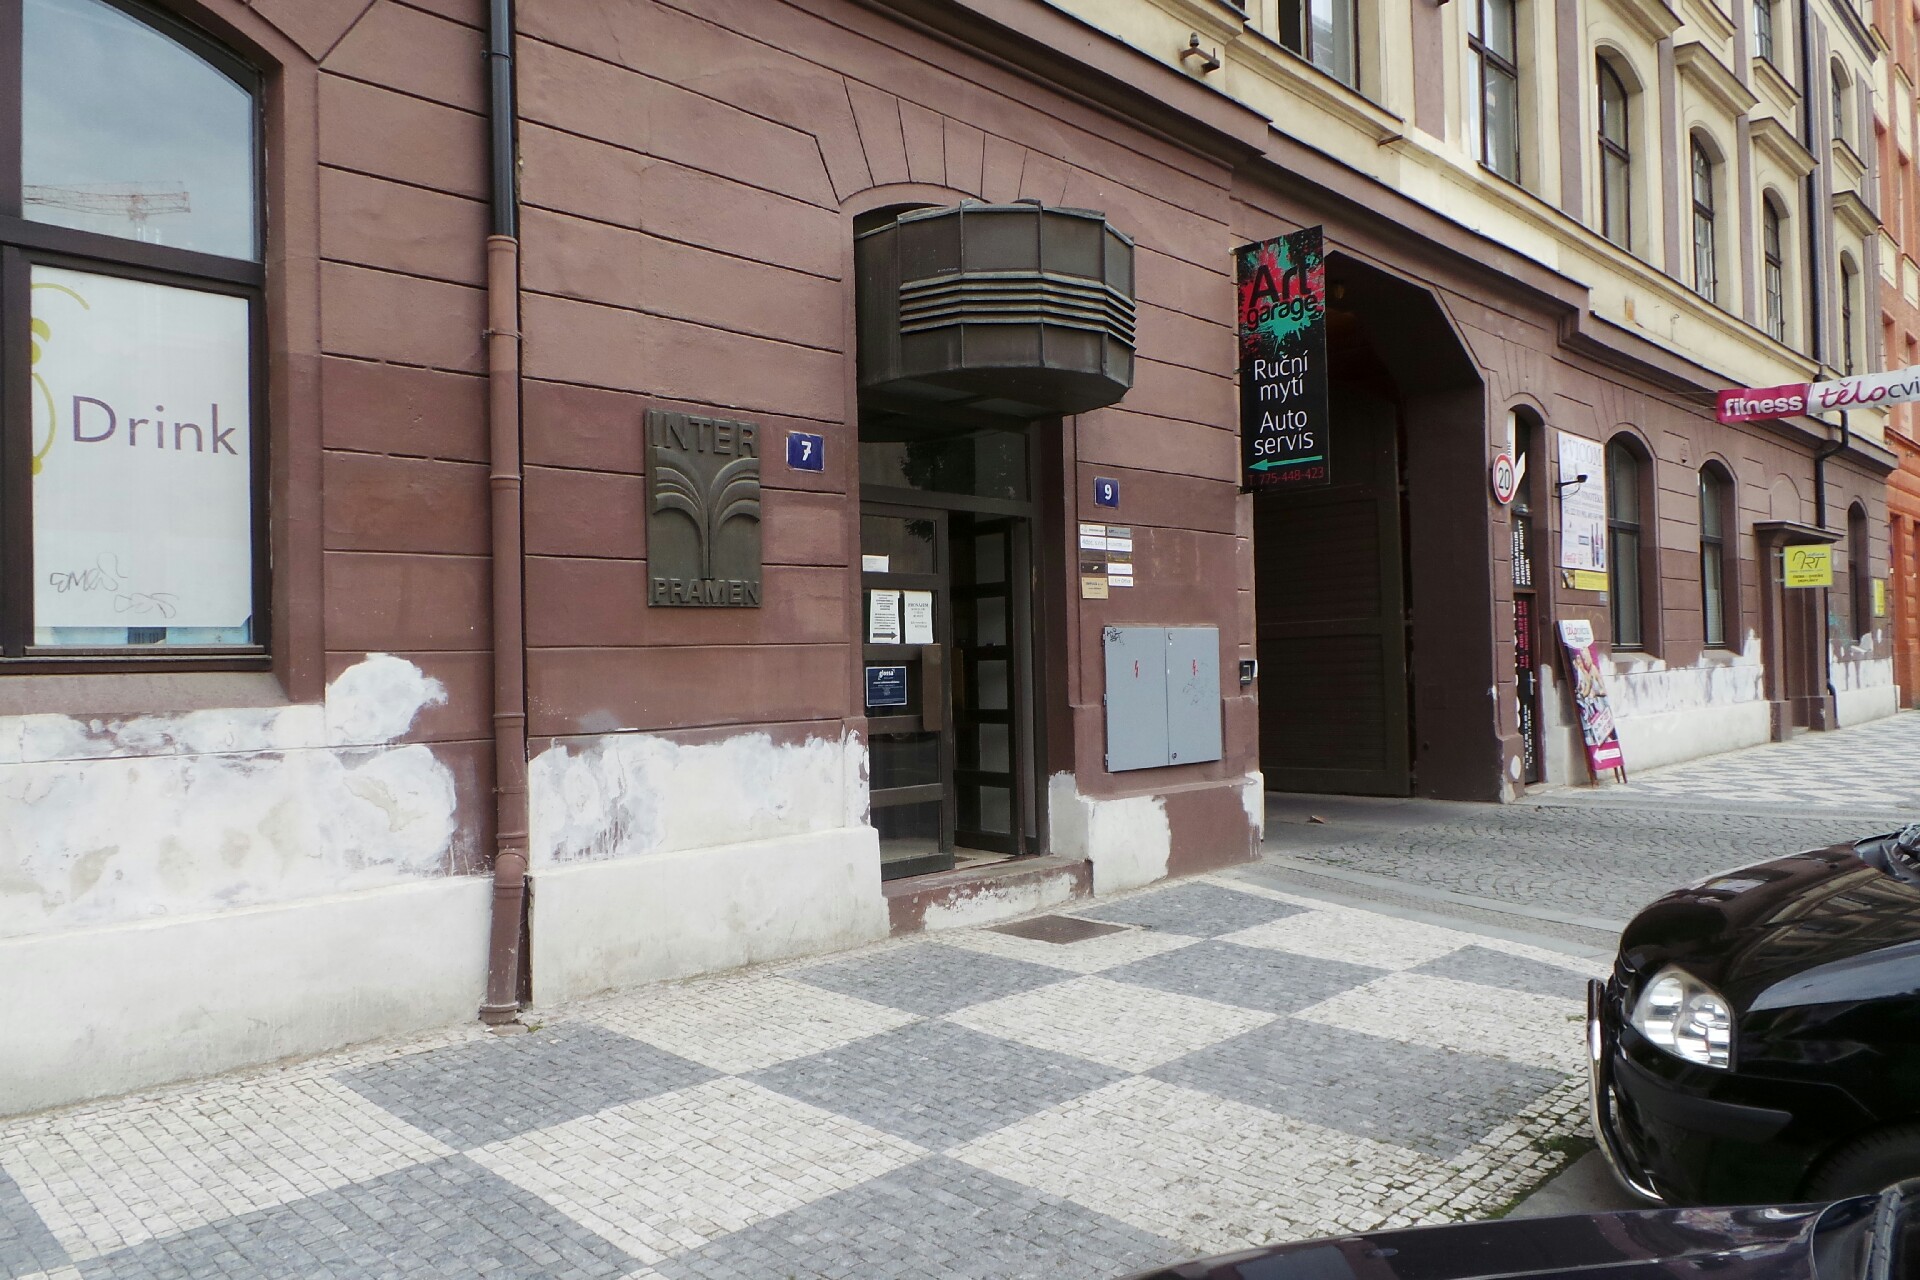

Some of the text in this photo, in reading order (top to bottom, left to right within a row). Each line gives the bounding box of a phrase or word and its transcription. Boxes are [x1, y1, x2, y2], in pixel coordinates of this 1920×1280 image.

[1248, 259, 1311, 308] Art
[1246, 295, 1318, 331] garage
[1254, 349, 1309, 381] Ruční
[1260, 372, 1304, 404] mytí
[1724, 395, 1804, 417] fitness
[72, 395, 239, 456] Drink
[651, 410, 760, 459] INTER
[1259, 409, 1308, 434] Auto
[801, 440, 812, 461] 7
[1254, 429, 1314, 456] servis
[1104, 484, 1113, 501] 9
[1498, 467, 1511, 491] 20
[653, 577, 760, 606] PRAMEN
